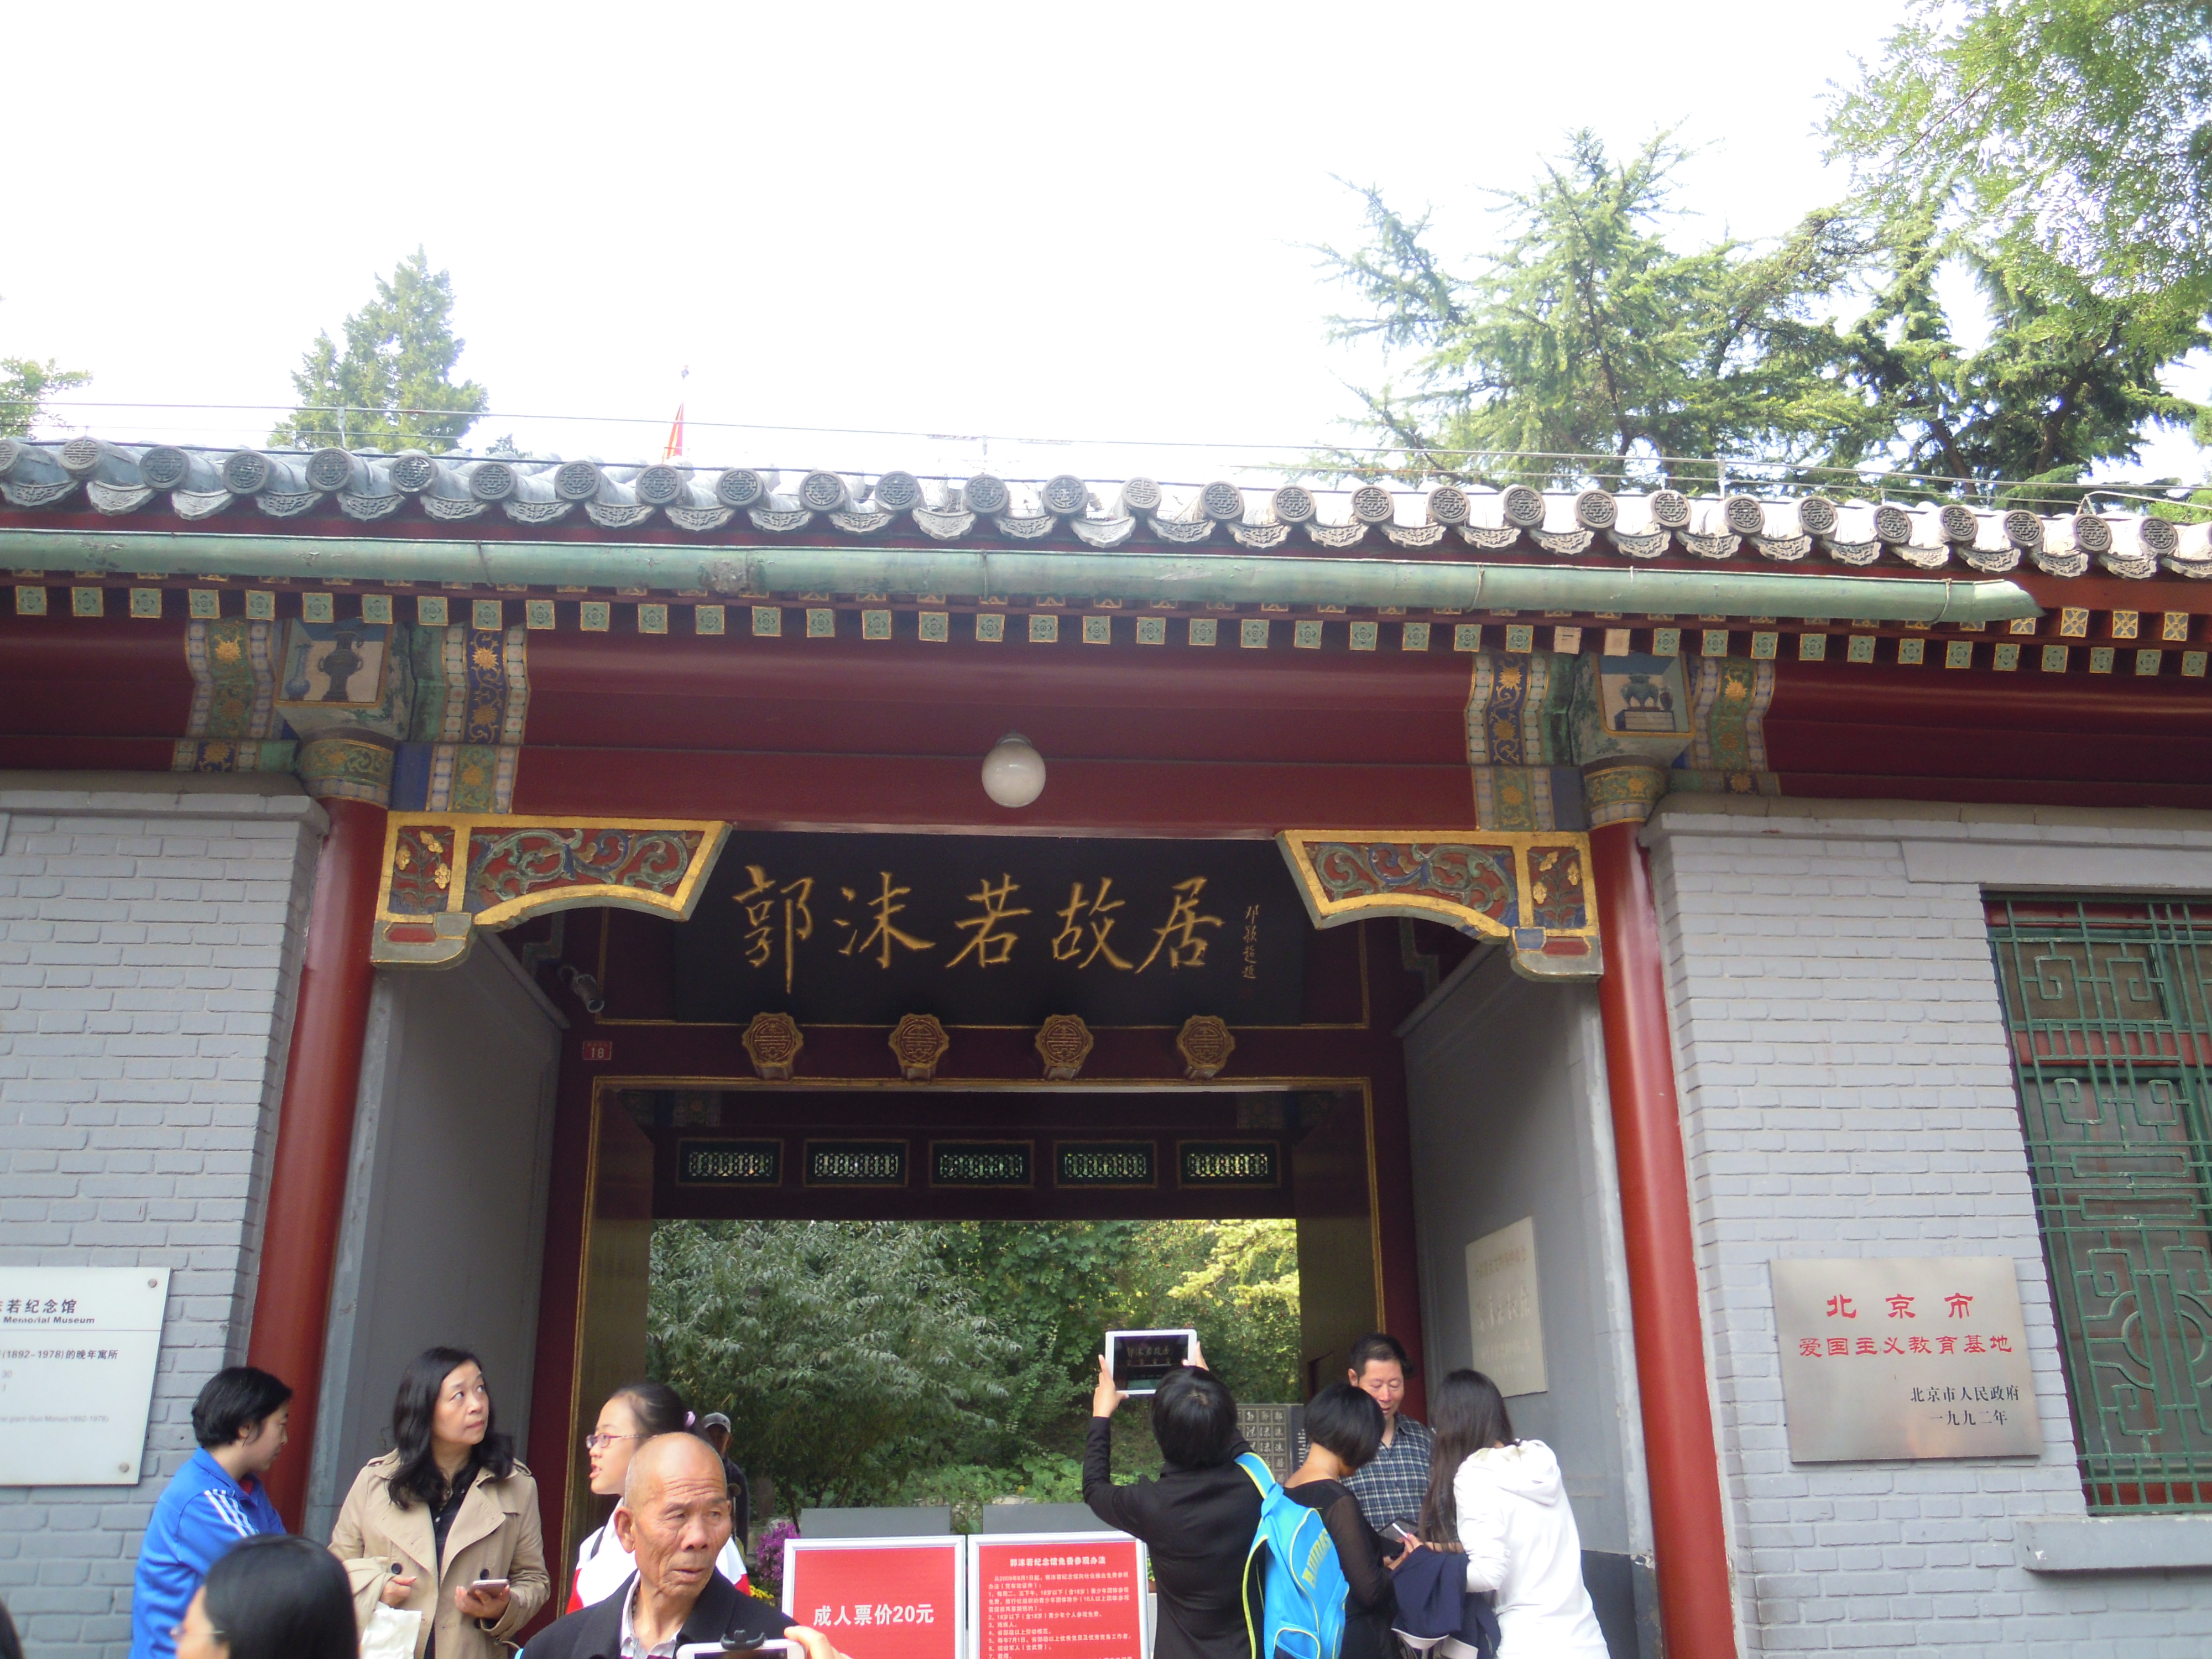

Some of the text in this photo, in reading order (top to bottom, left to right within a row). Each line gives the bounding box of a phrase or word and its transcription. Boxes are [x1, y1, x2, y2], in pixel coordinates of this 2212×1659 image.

[732, 864, 1224, 994] 郭沫若故居
[592, 1047, 604, 1058] 18
[0, 1298, 77, 1314] 若纪念馆
[1826, 1292, 1973, 1319] 北京市
[1799, 1334, 2012, 1358] 爱国主义教育基地
[1910, 1385, 2019, 1403] 北京市人民政府
[1929, 1410, 2008, 1426] 一九九二年
[813, 1604, 935, 1627] 成人票价20元
